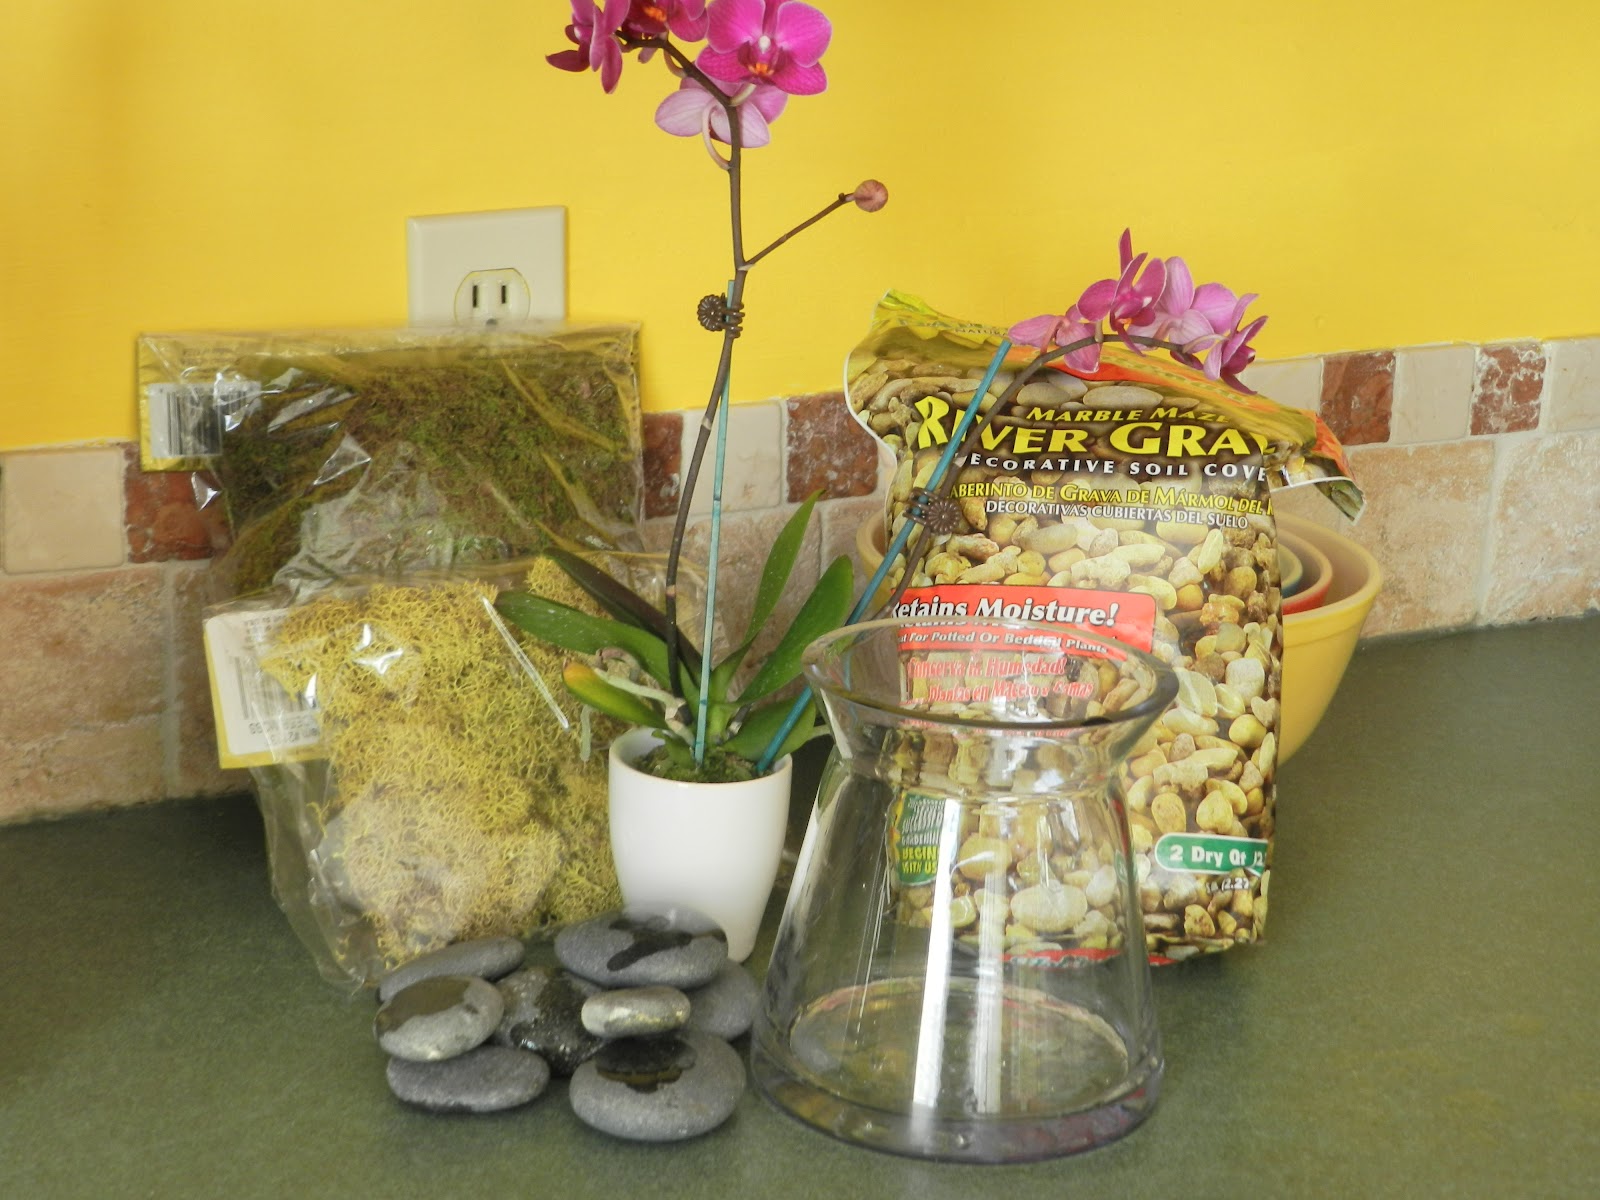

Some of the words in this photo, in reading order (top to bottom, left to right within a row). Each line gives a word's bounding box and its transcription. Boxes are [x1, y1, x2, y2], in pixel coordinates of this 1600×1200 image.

[1026, 407, 1143, 422] MARBLE
[957, 452, 1115, 474] ECORATIVE
[1130, 462, 1188, 476] SOIL
[948, 482, 1028, 499] ABERINTO
[1032, 486, 1055, 500] DE
[1060, 484, 1122, 502] GRAVA
[1127, 489, 1150, 504] DE
[1154, 486, 1234, 511] MÁRMOL
[1238, 498, 1263, 515] DEL
[986, 500, 1088, 517] DECORATIVAS
[1091, 505, 1172, 522] CUBIERTAS
[1177, 510, 1203, 525] DEL
[1207, 513, 1248, 529] SUELO
[974, 597, 1119, 627] Moisture!
[909, 632, 929, 642] For
[931, 632, 976, 643] Potted
[979, 632, 1000, 643] Or
[1066, 639, 1108, 653] Plants
[1169, 844, 1184, 862] 2
[1191, 845, 1224, 868] Dry
